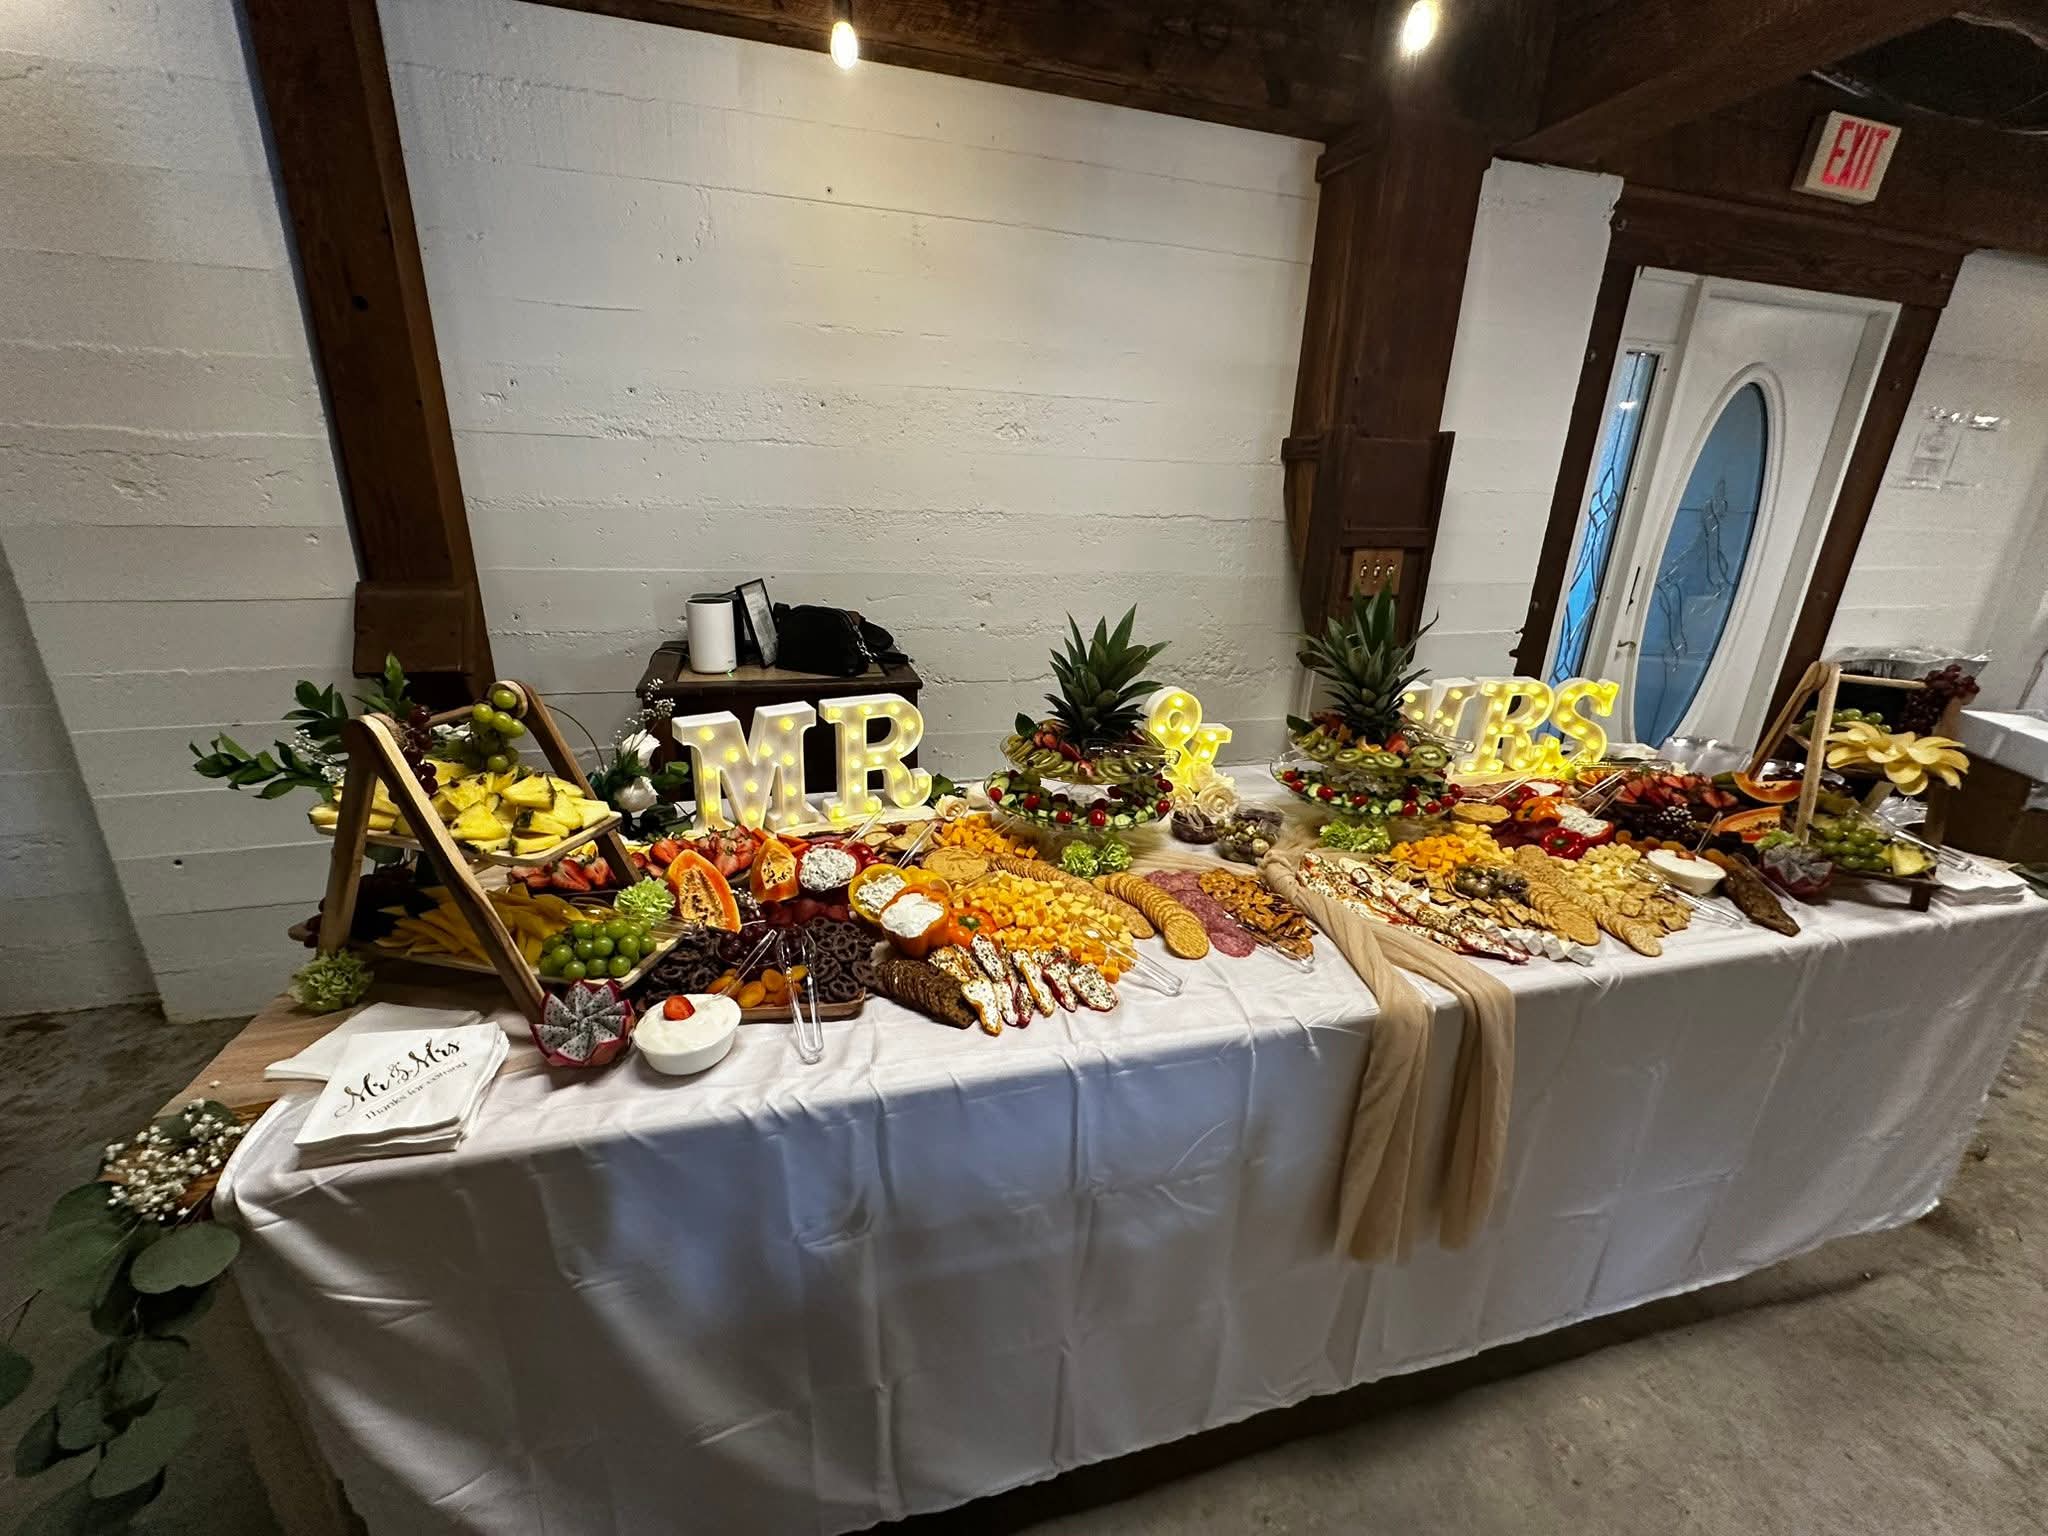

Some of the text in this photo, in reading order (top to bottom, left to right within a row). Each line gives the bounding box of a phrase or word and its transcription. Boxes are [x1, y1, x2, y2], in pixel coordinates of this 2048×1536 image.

[1822, 120, 1891, 191] EXIT
[672, 693, 932, 832] MR
[1144, 686, 1232, 787] &
[334, 1037, 460, 1118] Mr & Mrs
[365, 1062, 468, 1119] Thanks for coming
